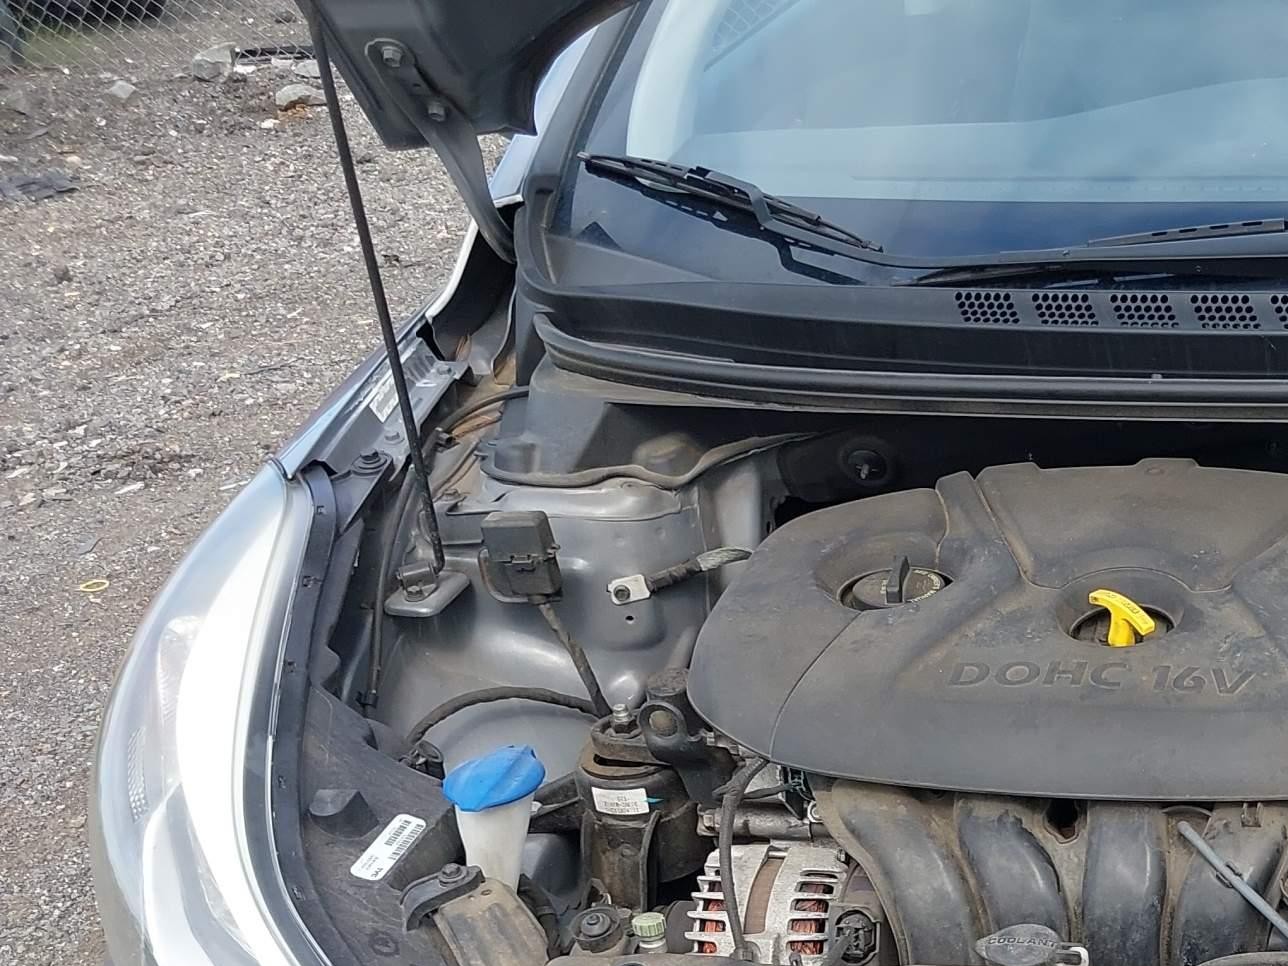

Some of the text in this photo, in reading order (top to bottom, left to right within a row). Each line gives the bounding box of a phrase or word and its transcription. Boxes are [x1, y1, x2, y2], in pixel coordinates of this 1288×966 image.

[949, 661, 1256, 697] DOHC 16V
[987, 937, 1058, 948] COOLANT
